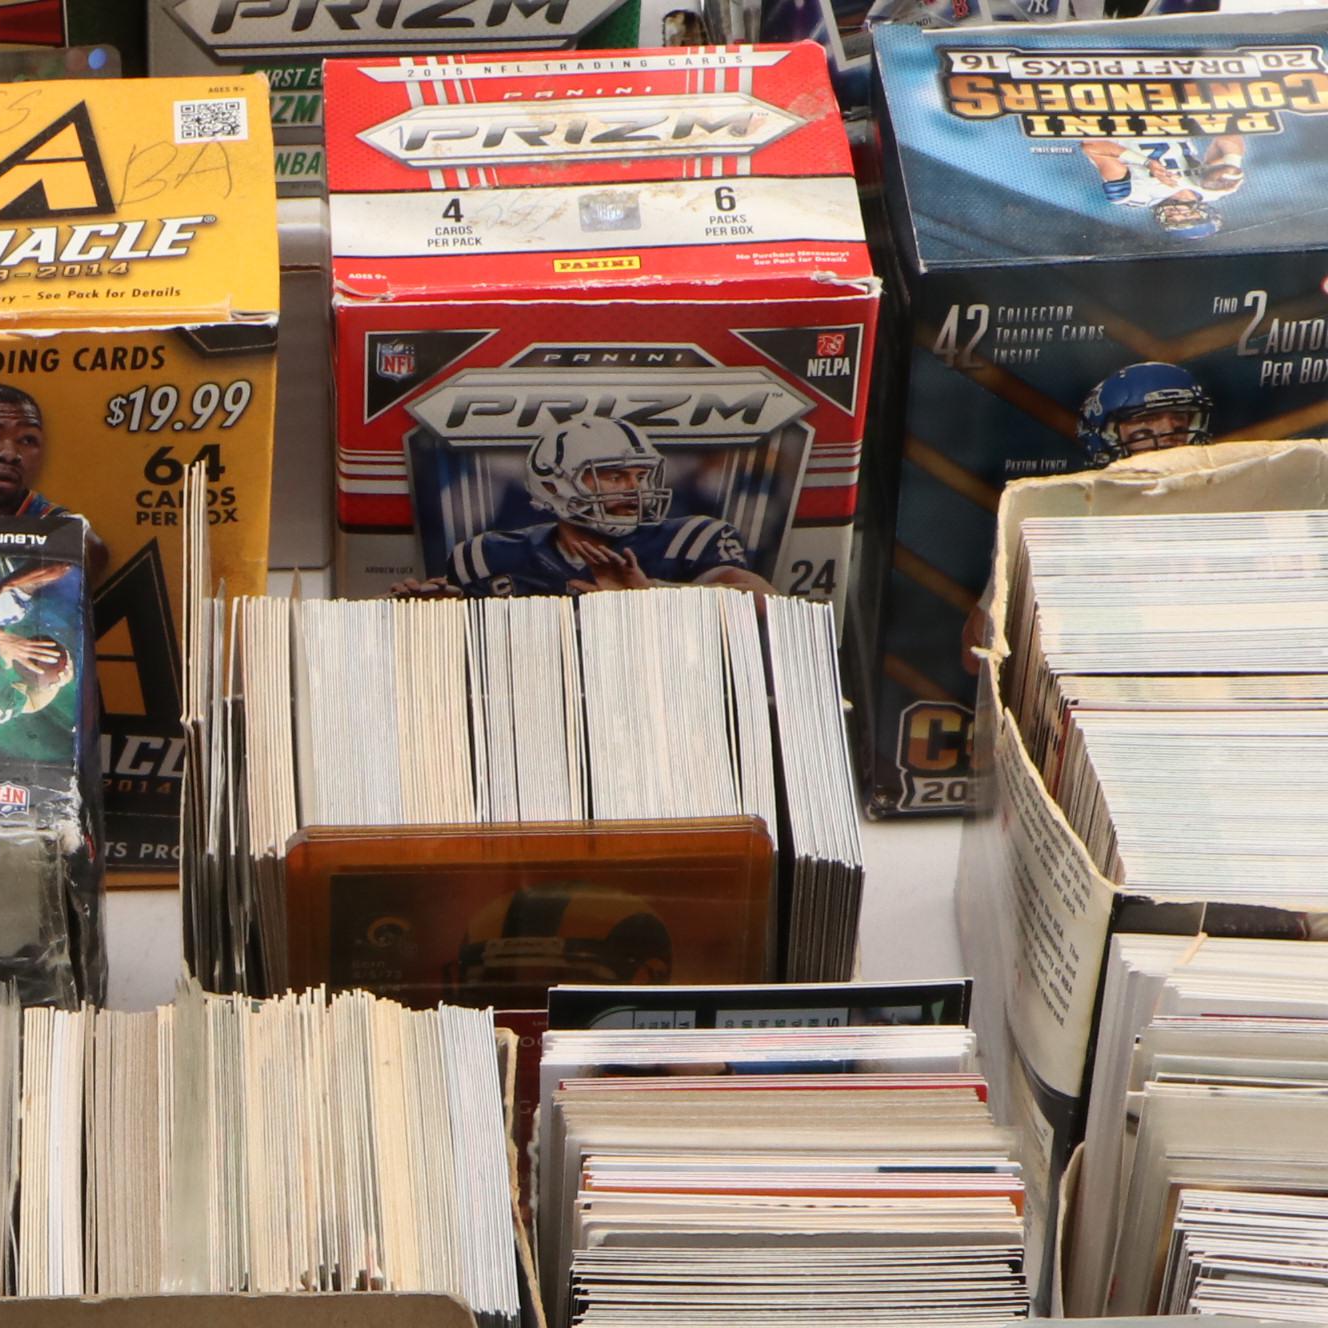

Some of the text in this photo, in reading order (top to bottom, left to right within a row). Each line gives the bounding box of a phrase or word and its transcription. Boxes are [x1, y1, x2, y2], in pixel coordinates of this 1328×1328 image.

[407, 55, 744, 78] 2015 NFL TRADING CARDS
[961, 53, 1307, 76] 20 DRAFT PICKS 16
[946, 73, 1328, 117] CONTENDERS
[403, 111, 755, 152] PRIZM
[1030, 113, 1275, 136] PANINI
[442, 197, 464, 223] 4
[714, 186, 737, 212] 6
[434, 226, 473, 237] CARDS
[705, 225, 754, 237] PER BOX
[709, 214, 747, 226] PACKS
[427, 236, 482, 248] PER PACK
[37, 290, 61, 301] See
[67, 288, 100, 300] Pack
[105, 288, 126, 299] for
[132, 286, 182, 299] Details
[997, 305, 1073, 323] COLLECTOR
[932, 304, 990, 368] 42
[72, 345, 166, 373] CARDS
[543, 352, 685, 363] PANINI
[807, 357, 851, 377] NFLPA
[105, 379, 253, 433] $19.99
[445, 391, 773, 430] PRIZM
[789, 560, 837, 595] 24
